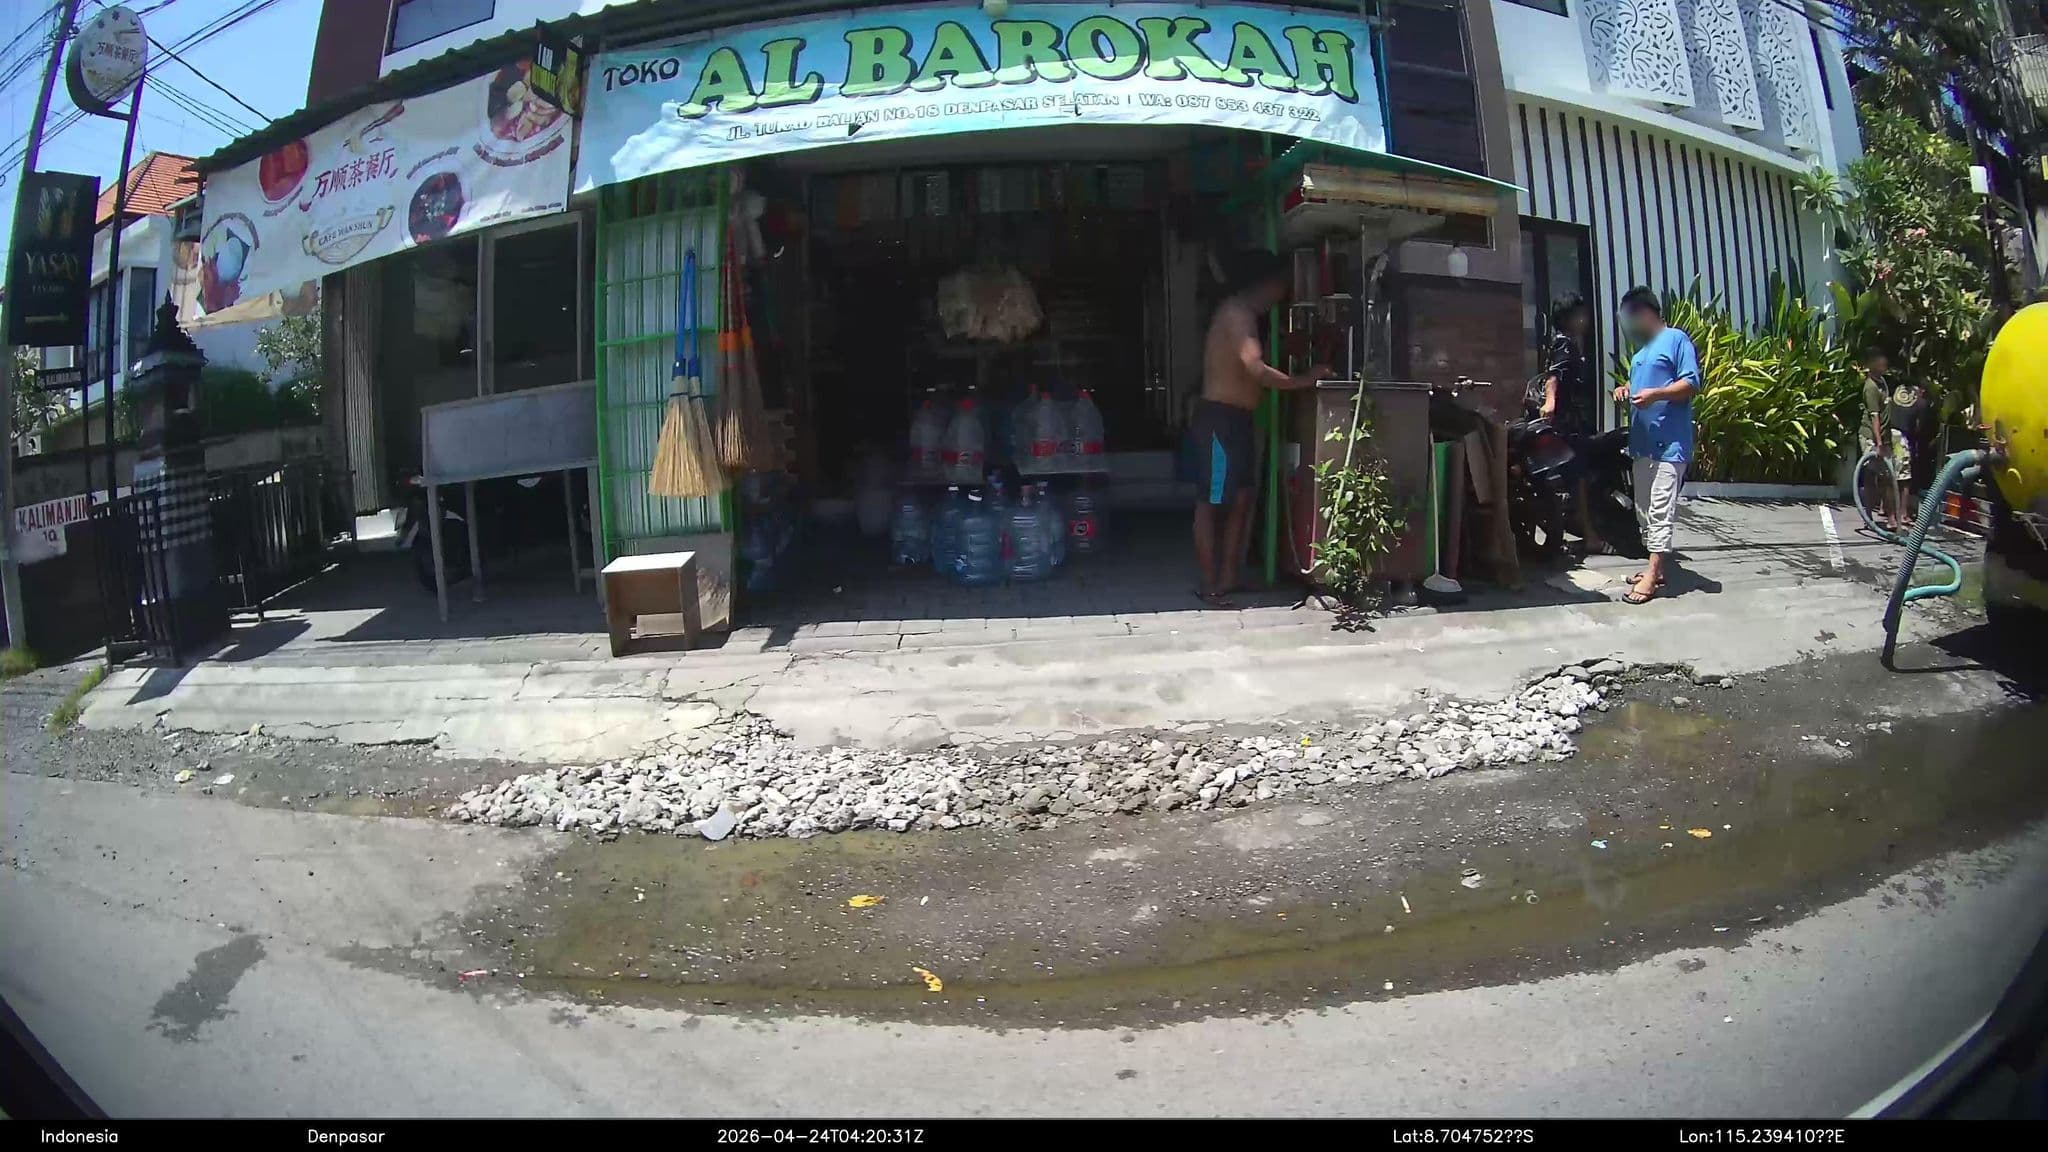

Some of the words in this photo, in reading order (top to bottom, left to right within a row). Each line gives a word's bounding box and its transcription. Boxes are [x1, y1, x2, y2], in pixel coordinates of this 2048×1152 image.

[602, 58, 680, 91] TOKO
[677, 37, 826, 119] AL
[839, 16, 1359, 104] BAROKAH
[726, 126, 750, 141] JL.
[944, 99, 1038, 116] DENPASAR
[1041, 93, 1120, 107] SELATAN
[1138, 93, 1172, 107] WA:
[1176, 94, 1210, 108] 087
[1215, 98, 1250, 112] 853
[1252, 102, 1283, 116] 437
[1288, 106, 1321, 122] 322
[312, 147, 396, 199] 万顺茶餐厅
